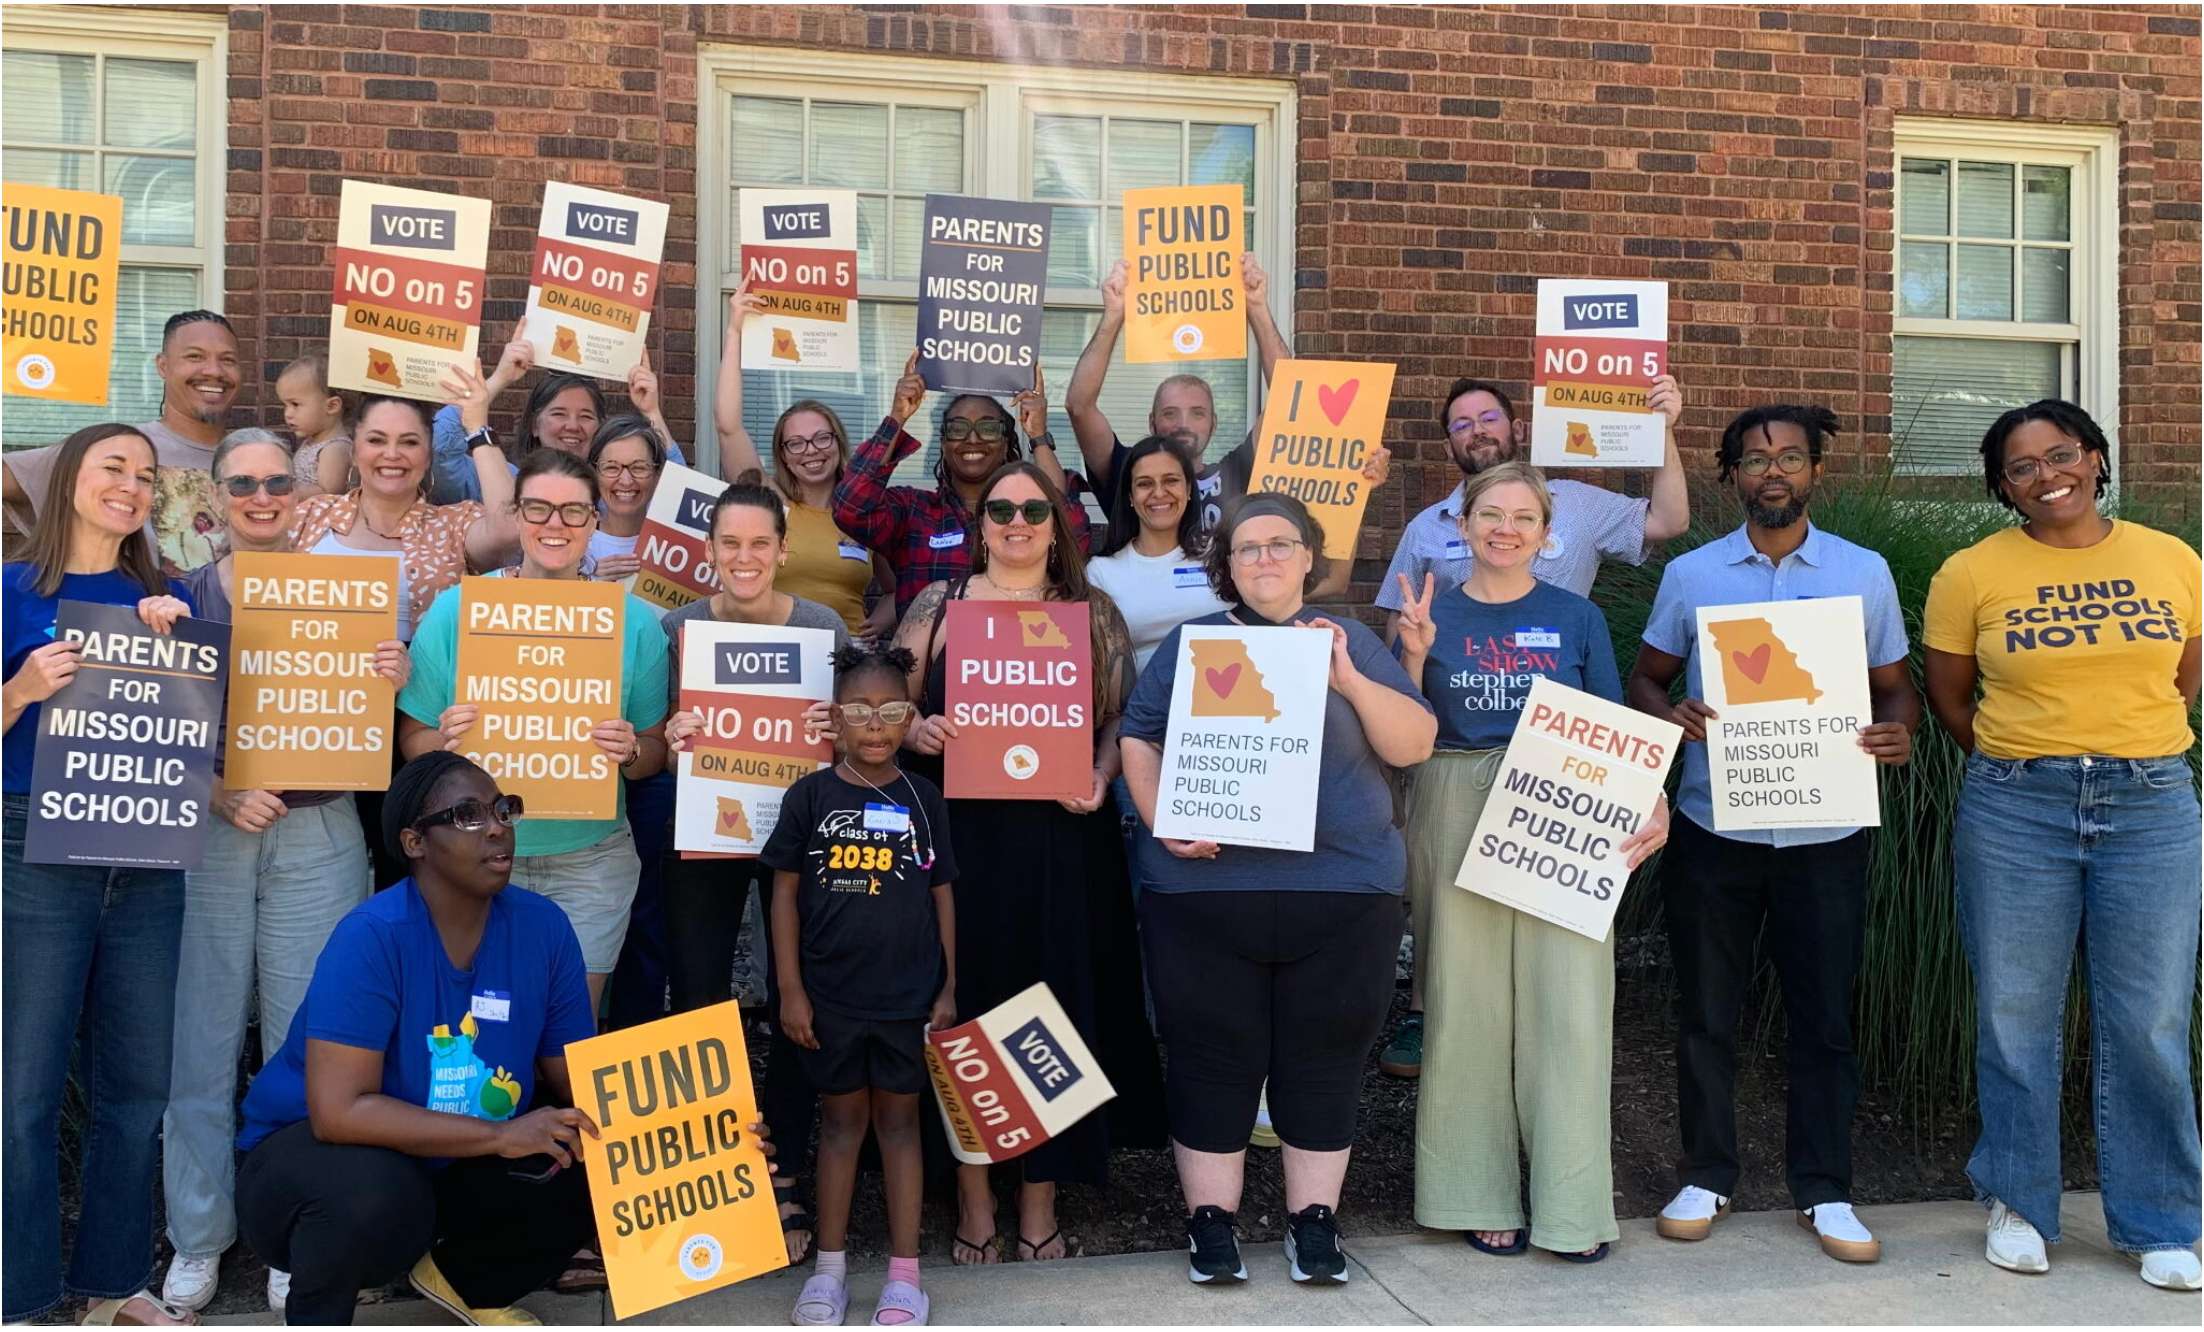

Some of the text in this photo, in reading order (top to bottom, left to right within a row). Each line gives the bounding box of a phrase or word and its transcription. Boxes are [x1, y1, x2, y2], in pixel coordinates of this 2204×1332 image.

[2, 206, 104, 261] UND
[382, 215, 445, 240] VOTE
[576, 212, 629, 235] VOTE
[772, 212, 821, 231] VOTE
[931, 216, 1043, 247] PARENTS
[1137, 204, 1230, 246] FUND
[541, 251, 649, 298] NO on 5
[750, 258, 849, 287] NO on 5
[966, 253, 1003, 273] FOR
[1138, 251, 1231, 282] PUBLIC
[2, 262, 99, 306] UBLIC
[345, 263, 474, 310] NO on 5
[926, 276, 1038, 306] MISSOURI
[547, 290, 633, 326] ON AUG 4TH
[760, 295, 840, 315] ON AUG 4TH
[1136, 288, 1234, 315] SCHOOLS
[1573, 302, 1629, 321] VOTE
[2, 308, 98, 346] HOOLS
[354, 309, 458, 343] ON AUG 4TH
[938, 309, 1022, 335] PUBLIC
[922, 337, 1032, 367] SCHOOLS
[1544, 348, 1658, 377] NO on 5
[1288, 380, 1303, 422] I
[1553, 387, 1647, 407] ON AUG 4TH
[1269, 433, 1366, 471] PUBLIC
[1260, 474, 1358, 506] SCHOOLS
[642, 535, 688, 573] NO
[243, 577, 389, 608] PARENTS
[642, 579, 697, 607] ON AU
[2037, 579, 2135, 604] FUND
[469, 602, 614, 634] PARENTS
[2005, 598, 2174, 626] SCHOOLS
[291, 619, 338, 640] FOR
[986, 617, 994, 638] I
[2006, 618, 2182, 653] NOT ICE
[65, 628, 218, 673] PARENTS
[240, 650, 383, 678] MISSOUR
[517, 645, 565, 666] FOR
[725, 652, 789, 675] VOTE
[1478, 653, 1560, 673] SHOW
[961, 659, 1077, 687] PUBLIC
[108, 678, 160, 704] FOR
[257, 688, 366, 715] PUBLIC
[466, 675, 611, 704] MISSOURI
[1464, 688, 1527, 711] colbe
[48, 708, 208, 748] MISSOURI
[483, 714, 592, 742] PUBLIC
[693, 705, 742, 739] NO
[753, 717, 792, 743] on
[954, 703, 1084, 728] SCHOOLS
[1723, 716, 1859, 738] PARENTS FOR
[236, 724, 383, 752] SCHOOLS
[1180, 732, 1308, 754] PARENTS FOR
[1529, 703, 1664, 769] PARENTS
[1177, 754, 1266, 775] MISSOURI
[1724, 742, 1819, 761] MISSOURI
[65, 751, 185, 786] PUBLIC
[701, 754, 808, 781] ON AUG 4TH
[1561, 756, 1608, 786] FOR
[1727, 767, 1795, 784] PUBLIC
[1175, 777, 1240, 796] PUBLIC
[1728, 788, 1822, 808] SCHOOLS
[40, 791, 198, 828] SCHOOLS
[1172, 799, 1262, 822] SCHOOLS
[1504, 767, 1641, 835] MISSOURI
[839, 828, 869, 840] class
[1507, 806, 1610, 861] PUBLIC
[829, 844, 893, 871] 2038
[1479, 833, 1614, 901] SCHOOLS
[435, 1064, 477, 1081] MISSOURI
[1019, 1030, 1070, 1088] VOTE
[434, 1084, 466, 1098] NEEDS
[592, 1037, 732, 1128] FUND
[941, 1036, 1031, 1149] NO on 5
[432, 1100, 470, 1114] PUBLIC
[926, 1051, 977, 1146] ON AUG 4TH
[605, 1108, 740, 1186] PUBLIC
[612, 1163, 755, 1238] SCHOOLS
